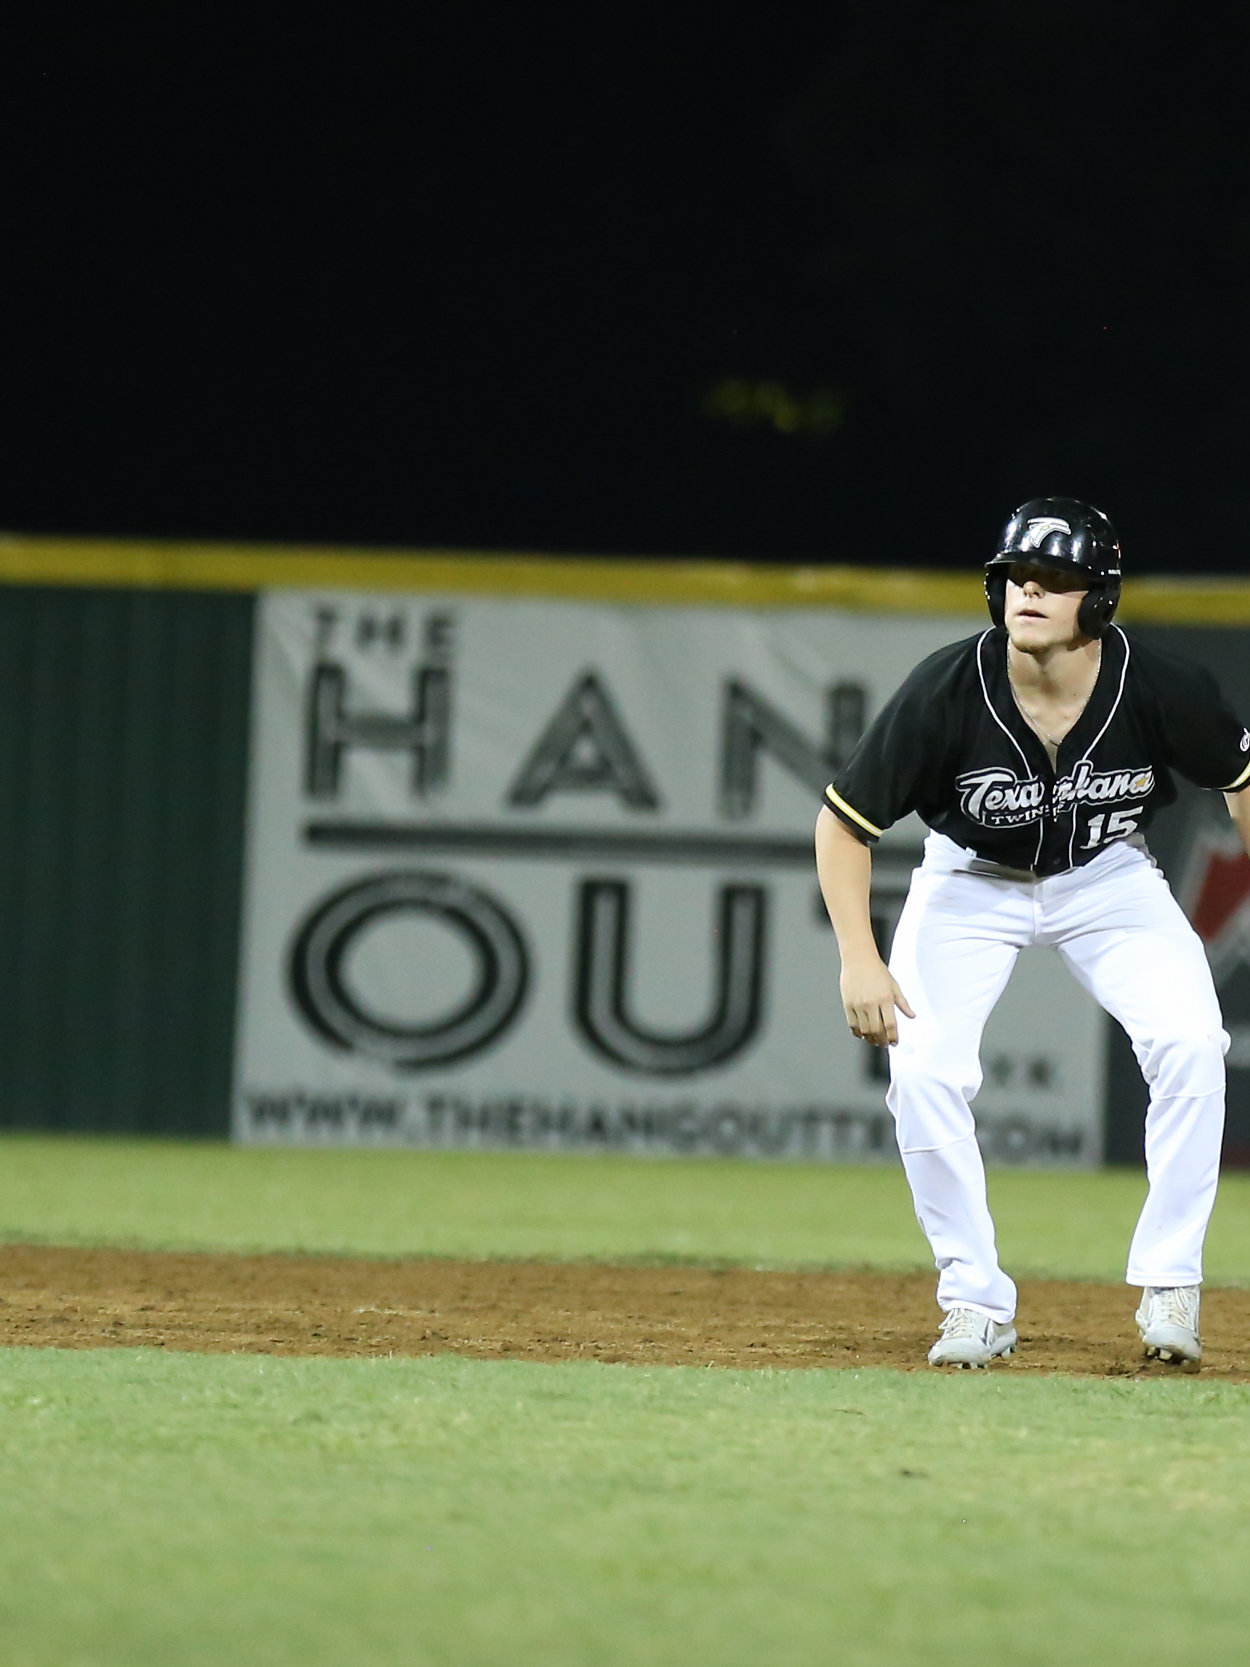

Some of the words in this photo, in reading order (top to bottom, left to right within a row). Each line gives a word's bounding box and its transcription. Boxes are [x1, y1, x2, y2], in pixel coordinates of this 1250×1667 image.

[311, 608, 458, 656] THE
[306, 663, 870, 816] HAN
[1080, 806, 1144, 850] 15
[287, 867, 893, 1086] OU
